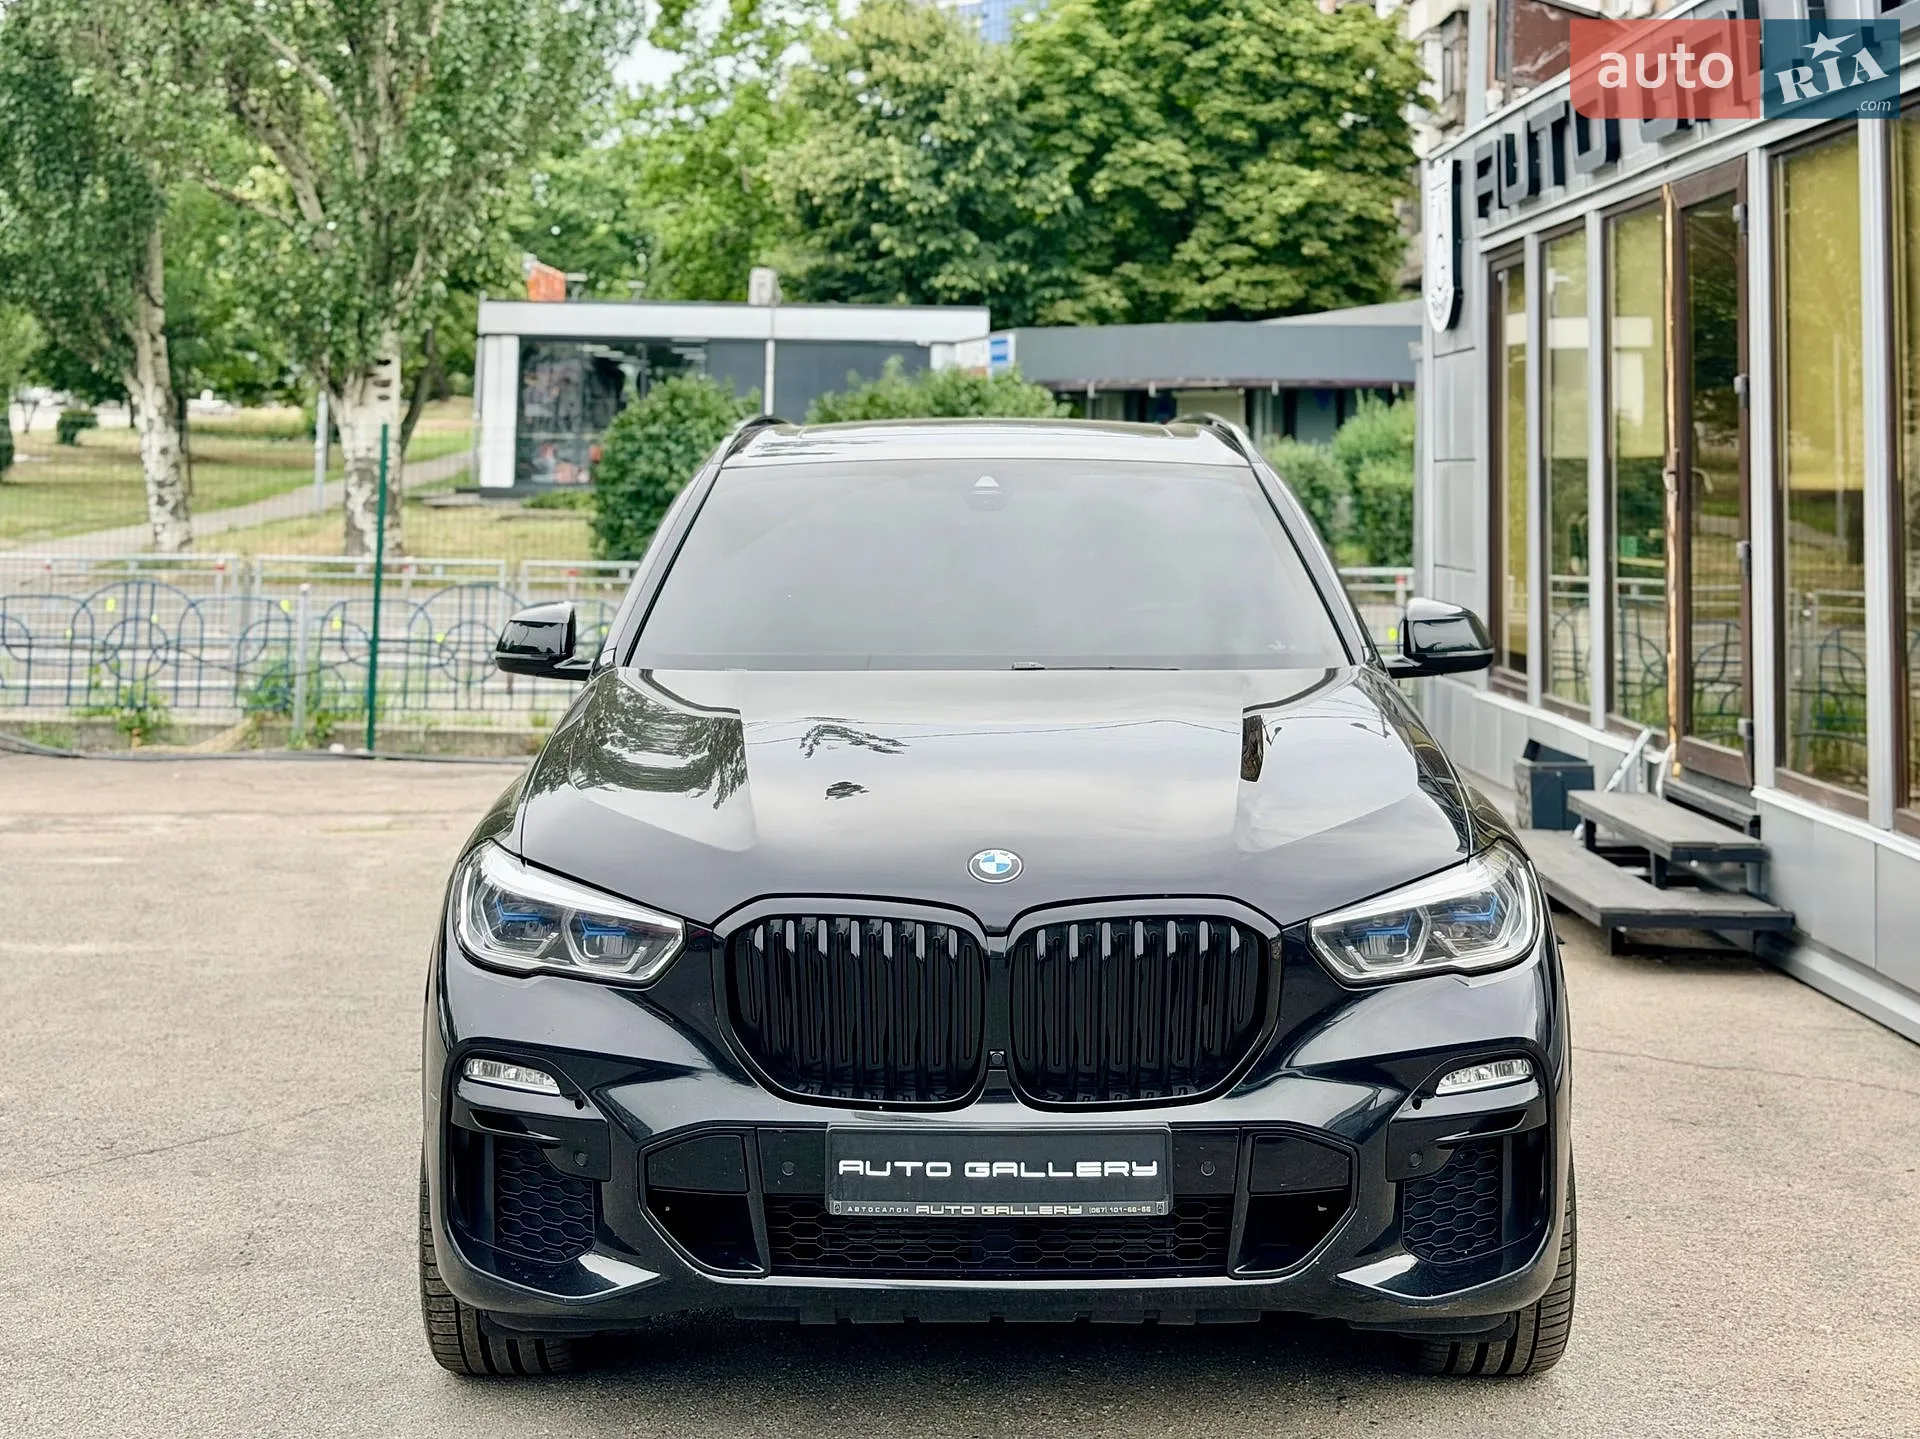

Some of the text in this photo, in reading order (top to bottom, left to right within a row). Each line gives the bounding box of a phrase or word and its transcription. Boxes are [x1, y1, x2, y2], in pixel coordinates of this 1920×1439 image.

[1474, 80, 1618, 217] AUTO
[838, 1159, 1158, 1178] AUTO GALLERY
[847, 1205, 909, 1213] АВТОСАЛОН
[915, 1204, 975, 1215] AUTO
[981, 1205, 1082, 1215] GALLERY
